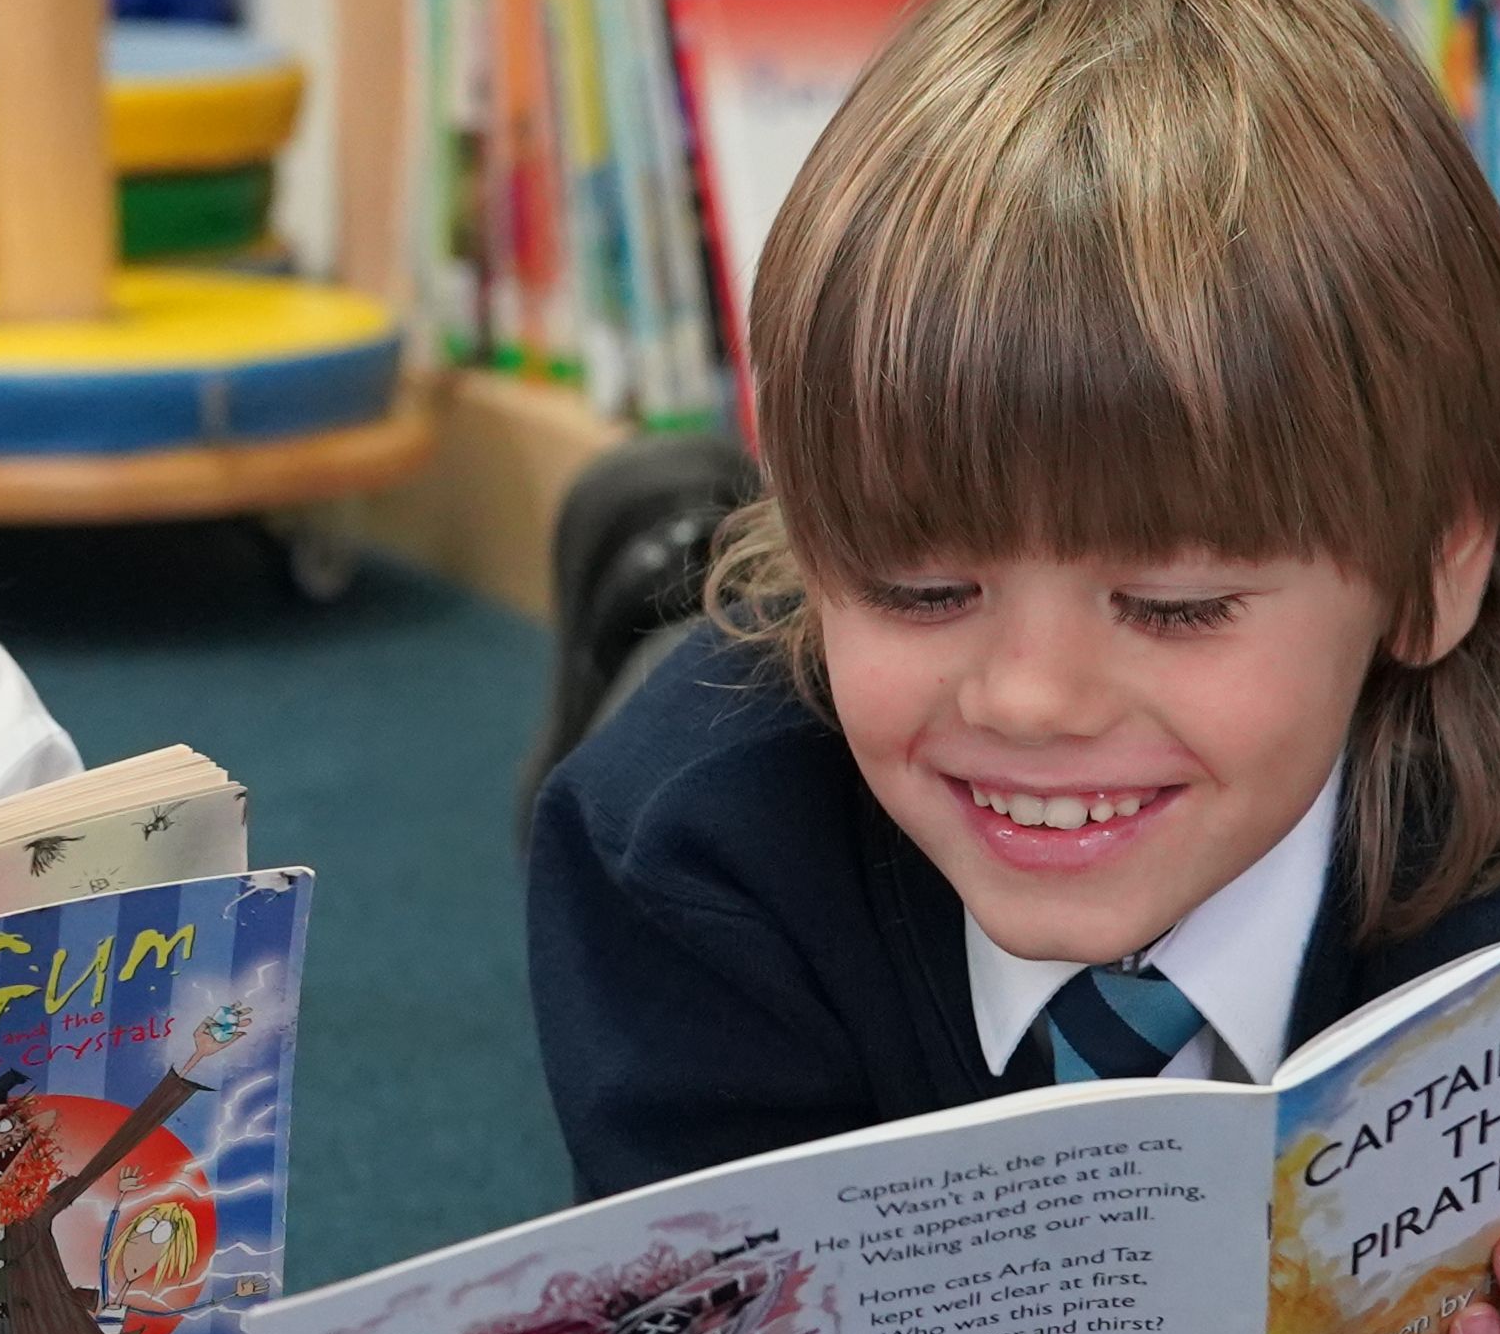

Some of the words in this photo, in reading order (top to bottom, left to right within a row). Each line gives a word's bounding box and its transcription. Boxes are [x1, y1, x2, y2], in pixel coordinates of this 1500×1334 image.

[2, 1023, 49, 1048] and
[61, 1009, 106, 1032] the
[20, 1015, 176, 1067] Crystals
[837, 1175, 934, 1206] Captain
[942, 1162, 998, 1189] Jack,
[1006, 1151, 1046, 1173] the
[1055, 1141, 1129, 1167] pirate
[1139, 1138, 1183, 1152] cat,
[875, 1192, 964, 1219] Wasn't
[972, 1189, 985, 1201] a
[994, 1170, 1066, 1202] pirate
[1076, 1167, 1101, 1182] at
[1109, 1161, 1143, 1179] all.
[814, 1236, 851, 1255] He
[858, 1224, 905, 1249] just
[913, 1200, 1027, 1237] appeared
[1036, 1193, 1083, 1210] one
[1092, 1181, 1207, 1202] morning,
[861, 1236, 963, 1267] Walking
[970, 1223, 1037, 1248] along
[1046, 1215, 1091, 1232] our
[1099, 1206, 1156, 1226] wall.
[858, 1282, 936, 1307] Home
[945, 1271, 992, 1292] cats
[999, 1257, 1052, 1280] Arfa
[1061, 1248, 1106, 1268] and
[1112, 1246, 1153, 1263] Taz
[871, 1304, 924, 1328] kept
[933, 1293, 981, 1315] well
[990, 1280, 1051, 1302] clear
[1059, 1276, 1083, 1292] at
[1091, 1271, 1148, 1288] first,
[1439, 1286, 1475, 1320] by
[954, 1313, 1000, 1330] was
[1010, 1303, 1053, 1321] this
[1062, 1294, 1135, 1317] pirate
[1085, 1315, 1165, 1334] thirst?
